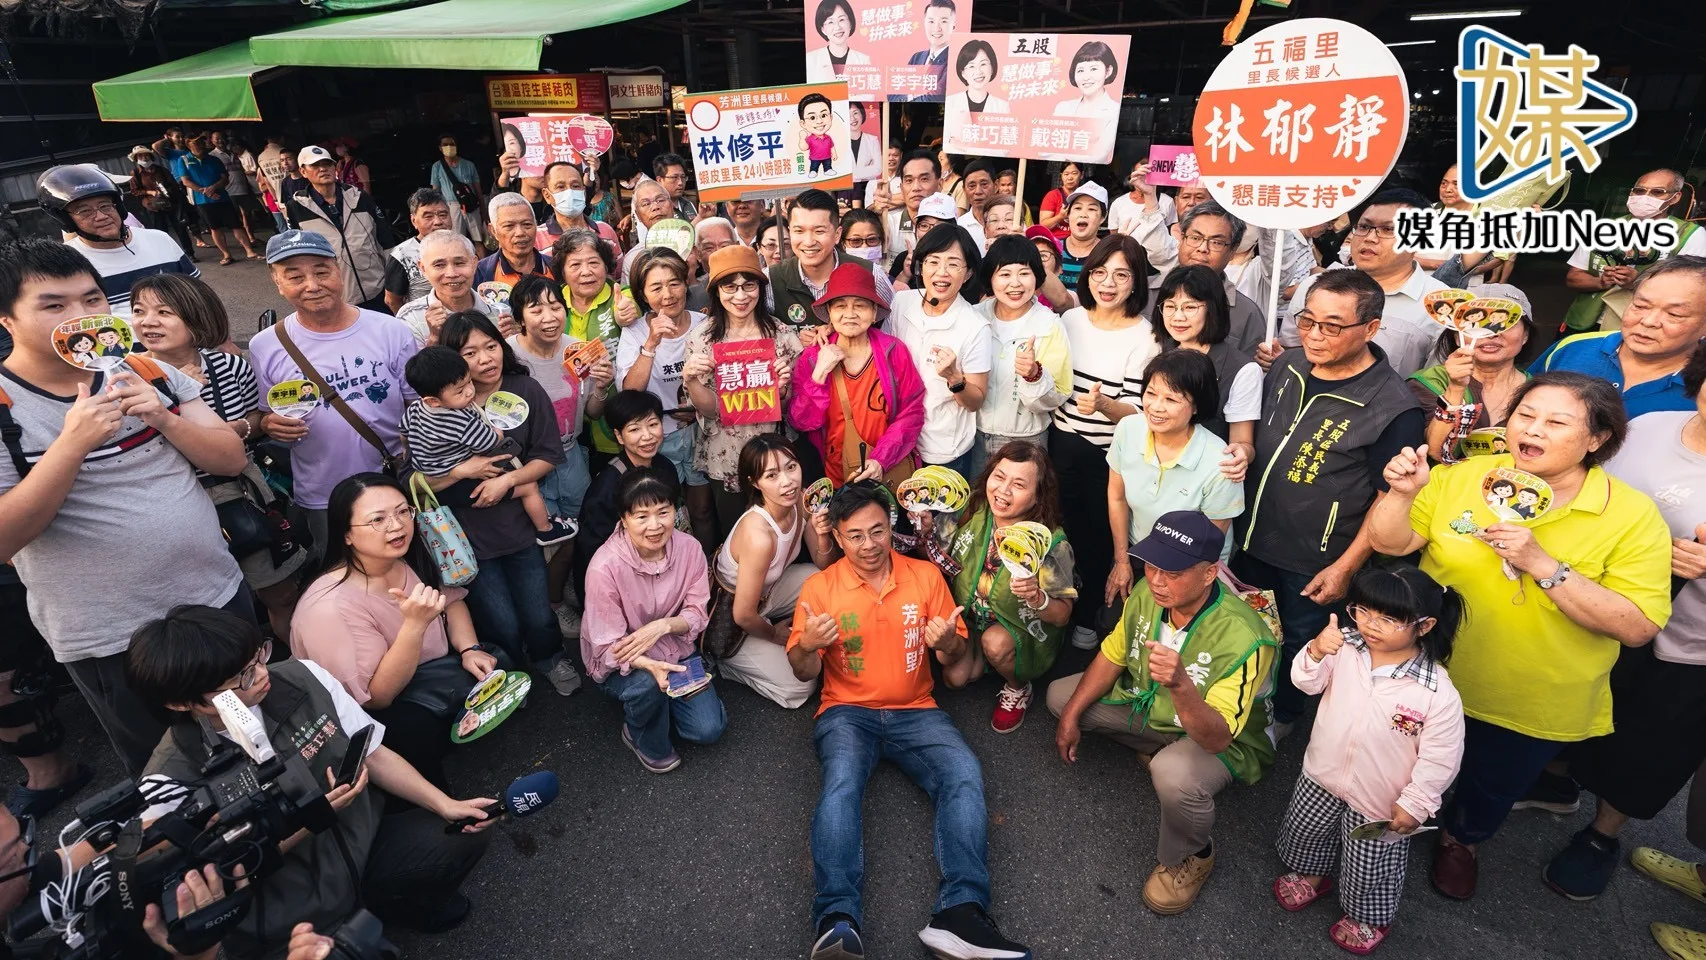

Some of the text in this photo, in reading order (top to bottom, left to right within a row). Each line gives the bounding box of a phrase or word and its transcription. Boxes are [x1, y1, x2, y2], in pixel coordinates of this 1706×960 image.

[1012, 37, 1052, 55] 五股
[1252, 31, 1339, 66] 五福里
[891, 74, 938, 91] 李宇翔
[1247, 63, 1341, 84] 里長候選人
[609, 83, 662, 98] 阿文生鮮豬肉
[719, 92, 790, 108] 芳洲里 里長候選人
[961, 123, 1019, 146] 蘇巧慧
[1030, 127, 1092, 150] 戴翎育
[1204, 93, 1388, 163] 林郁靜
[517, 120, 547, 167] 慧聚
[547, 120, 576, 164] 洋流
[696, 130, 784, 166] 林修平
[1231, 184, 1339, 209] 懇請支持
[717, 359, 774, 391] 慧贏
[720, 387, 777, 414] WIN
[1287, 418, 1334, 483] 里長 陳添福
[1155, 522, 1194, 546] TAIPOWER
[841, 612, 865, 678] 林修平
[902, 603, 919, 674] 芳洲里
[300, 719, 339, 761] 蘇巧慧
[512, 792, 543, 814] 民視
[117, 871, 135, 911] SONY
[204, 906, 240, 930] SONY
